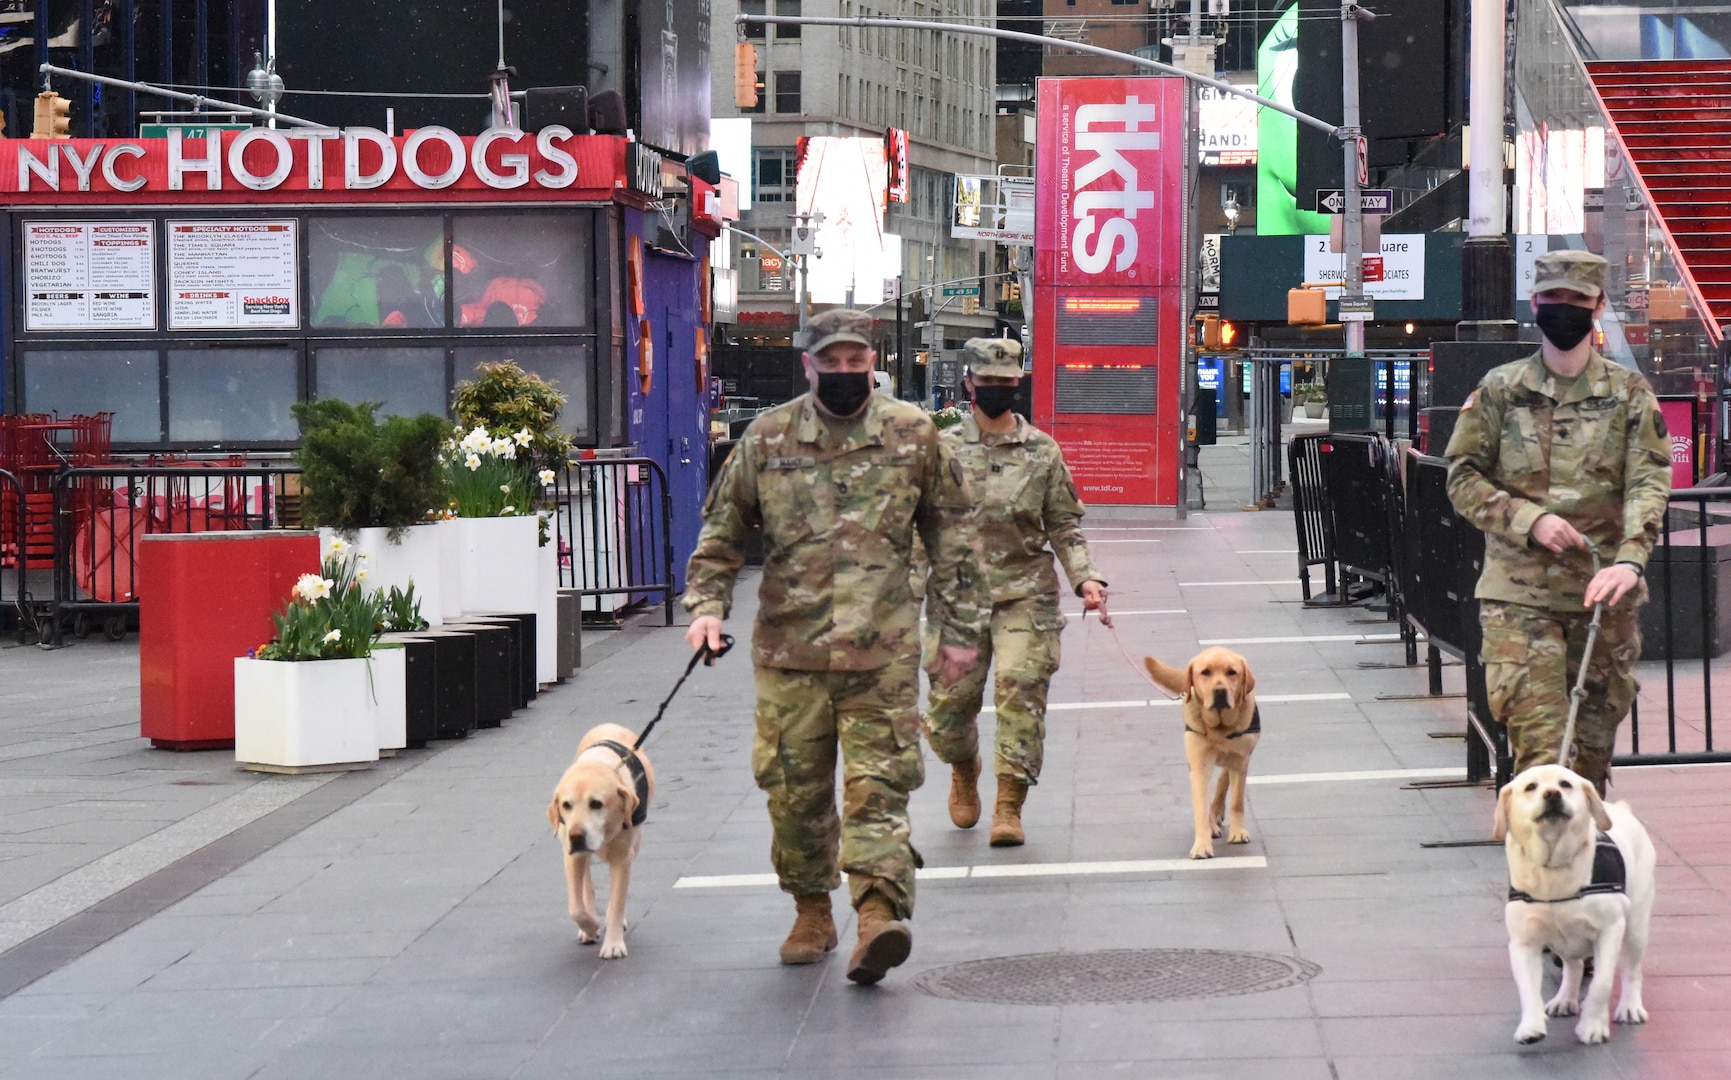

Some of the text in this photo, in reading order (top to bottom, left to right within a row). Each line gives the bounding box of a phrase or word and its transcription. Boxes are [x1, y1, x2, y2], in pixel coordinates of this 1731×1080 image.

[188, 130, 204, 138] 47
[1062, 146, 1069, 155] of
[18, 125, 578, 191] NYC HOTDOGS
[1061, 157, 1070, 190] Theatre
[1072, 96, 1160, 274] tkts
[1329, 198, 1344, 207] ON
[1060, 193, 1070, 249] Development
[1319, 241, 1408, 252] 2 uare
[1060, 252, 1068, 273] Fund
[1672, 436, 1692, 446] REE
[1083, 485, 1124, 493] www.tdf.org
